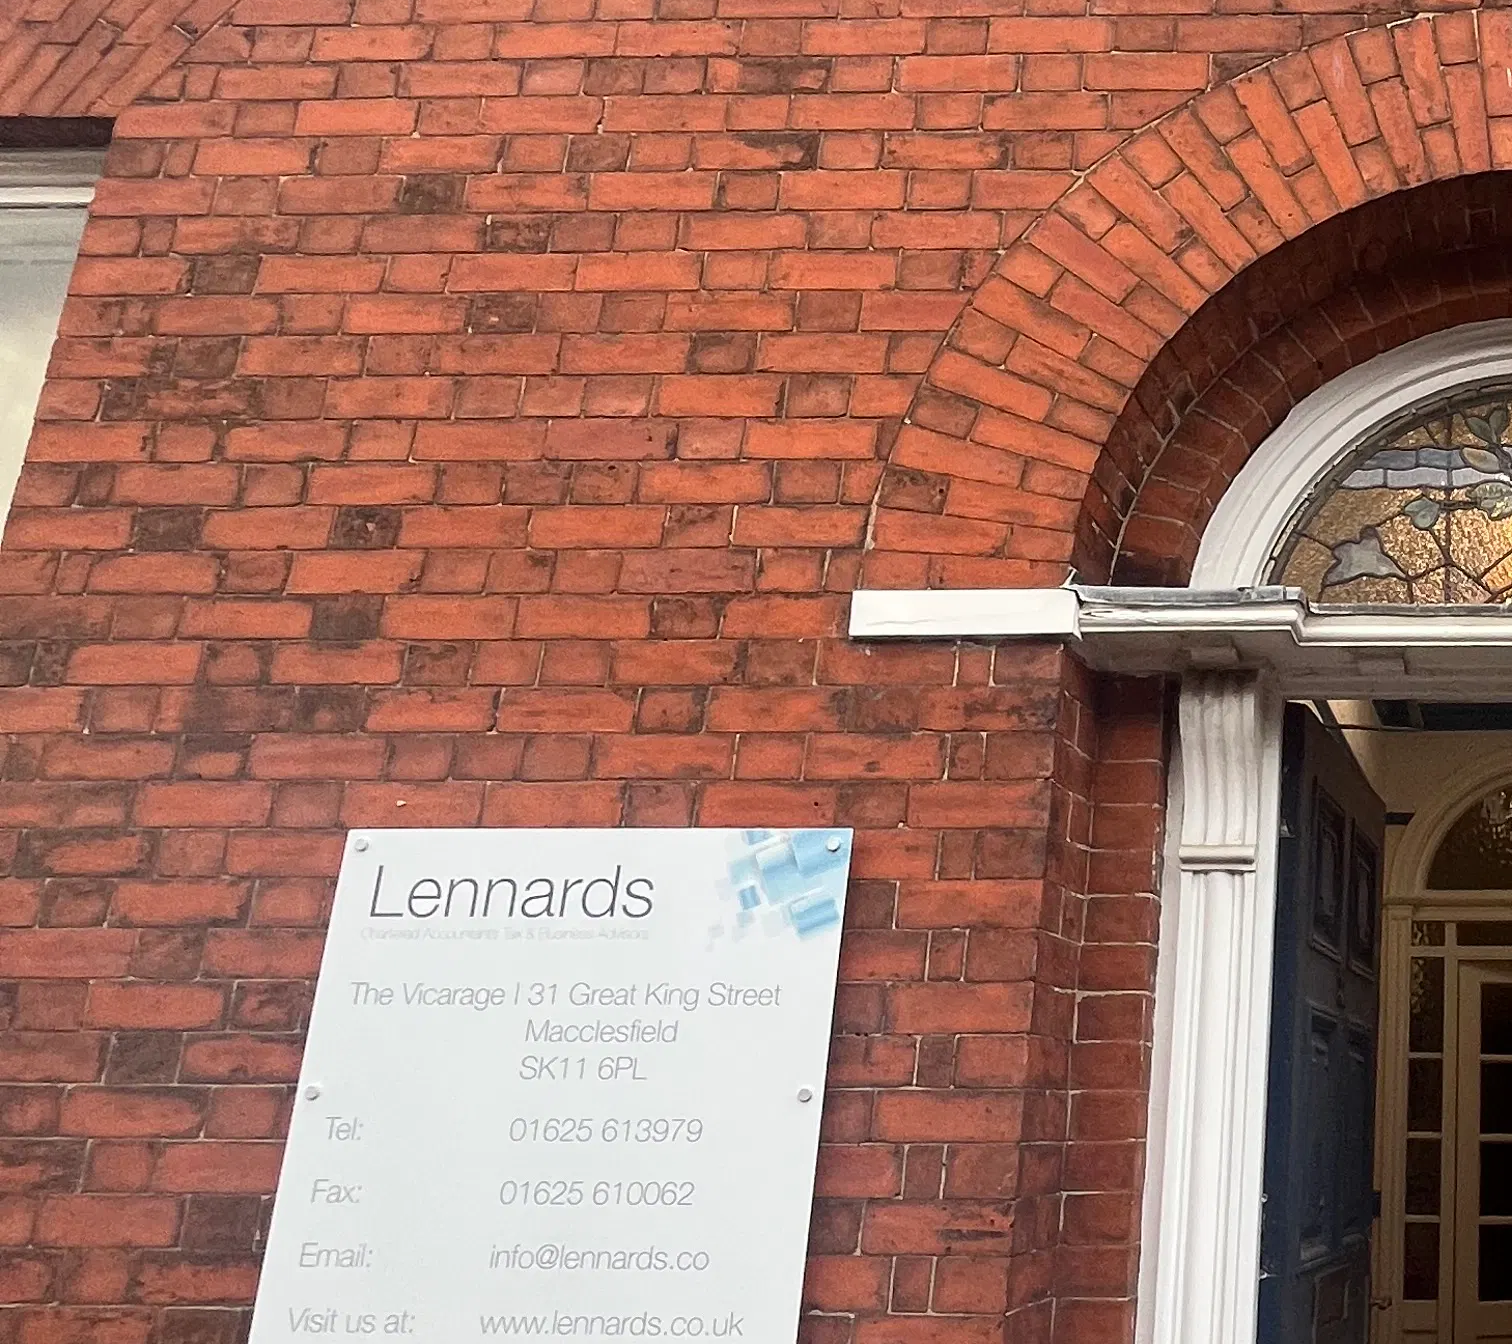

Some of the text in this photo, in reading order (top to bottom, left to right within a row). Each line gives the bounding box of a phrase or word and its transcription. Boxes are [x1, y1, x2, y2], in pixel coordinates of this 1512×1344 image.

[370, 865, 655, 919] Lennards
[351, 981, 394, 1006] The
[404, 982, 506, 1012] Vicarage
[527, 982, 558, 1006] 31
[568, 981, 638, 1007] Great
[644, 982, 700, 1012] King
[708, 981, 782, 1007] Street
[524, 1018, 679, 1043] Macclesfield
[519, 1055, 648, 1081] SK11 6PL
[325, 1116, 704, 1143] Tel: 01625 613979
[310, 1178, 695, 1206] Fax: 01625 610062
[299, 1242, 710, 1271] Email: info@lennards.co
[288, 1307, 744, 1337] Visit us at: www.lennards.co.uk
